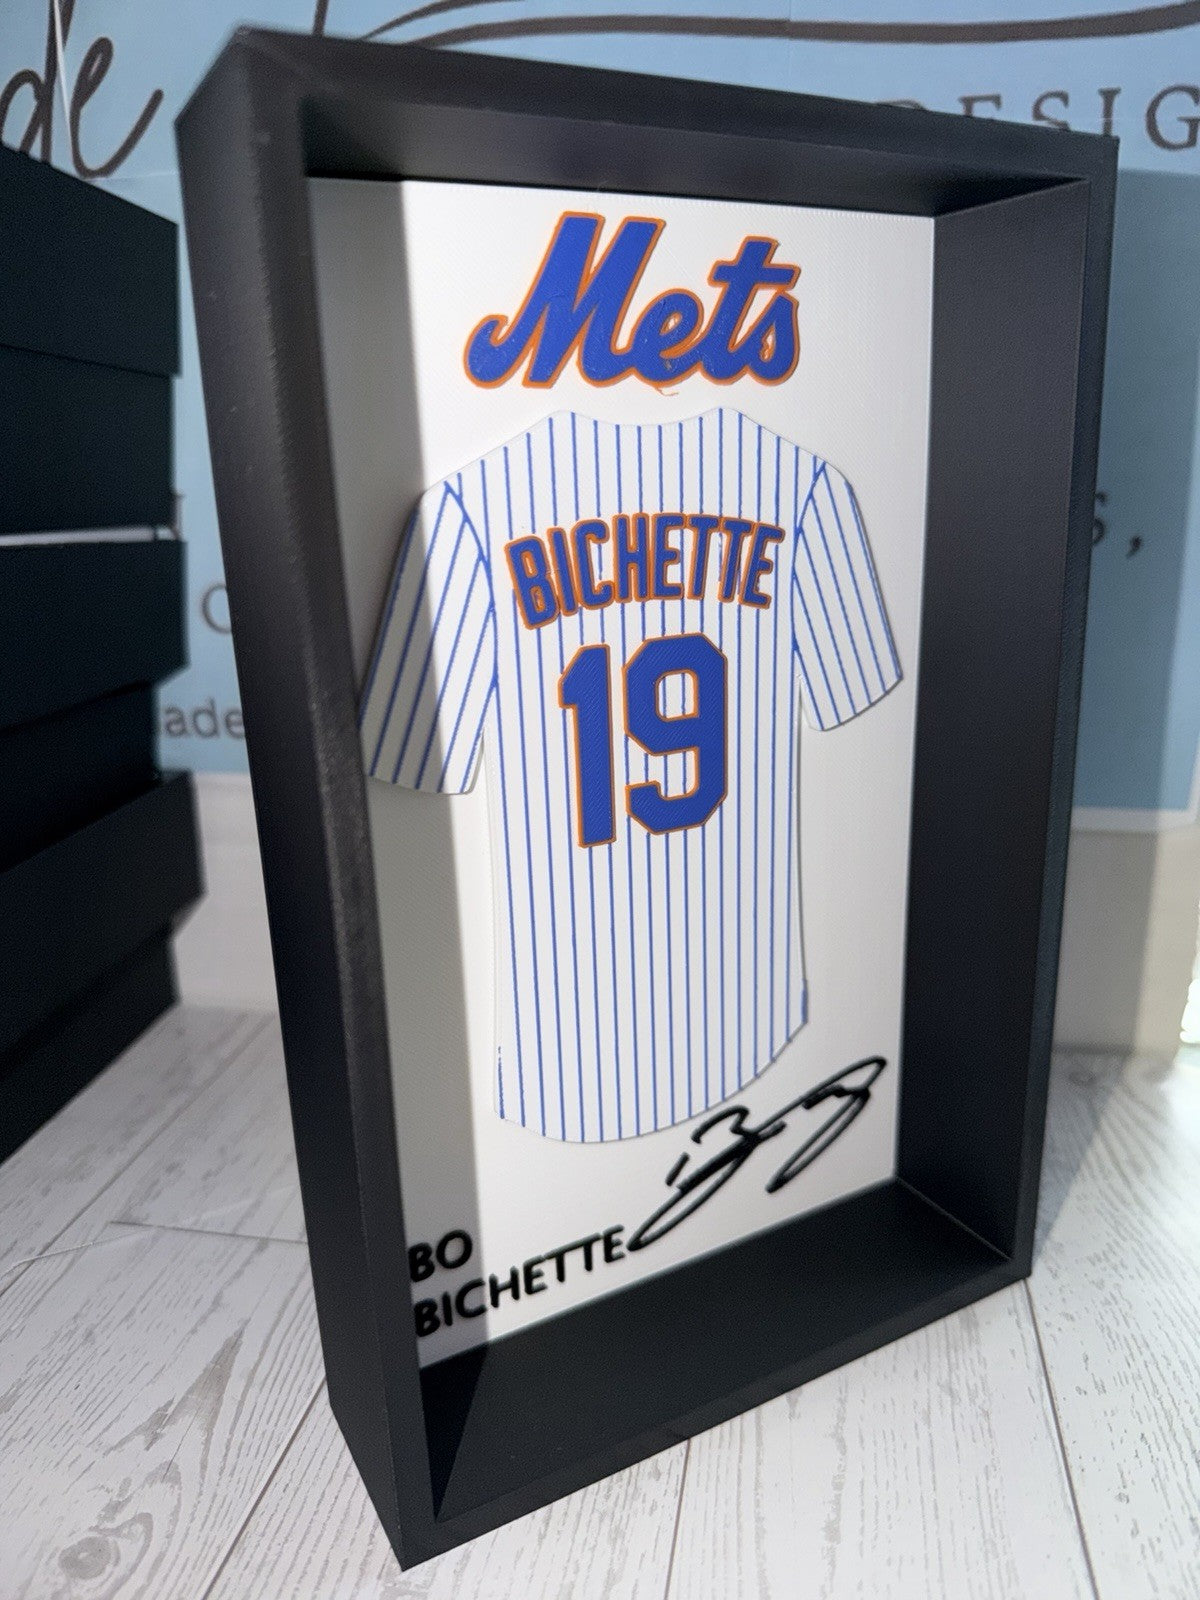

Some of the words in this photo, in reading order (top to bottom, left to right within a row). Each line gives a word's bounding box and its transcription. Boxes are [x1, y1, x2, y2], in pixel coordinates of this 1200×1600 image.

[873, 84, 1200, 151] SIG
[463, 210, 801, 388] Mets
[504, 512, 786, 630] BICHETTE
[558, 632, 728, 848] 19
[407, 1229, 473, 1284] BO
[413, 1225, 626, 1337] BICHETTE
